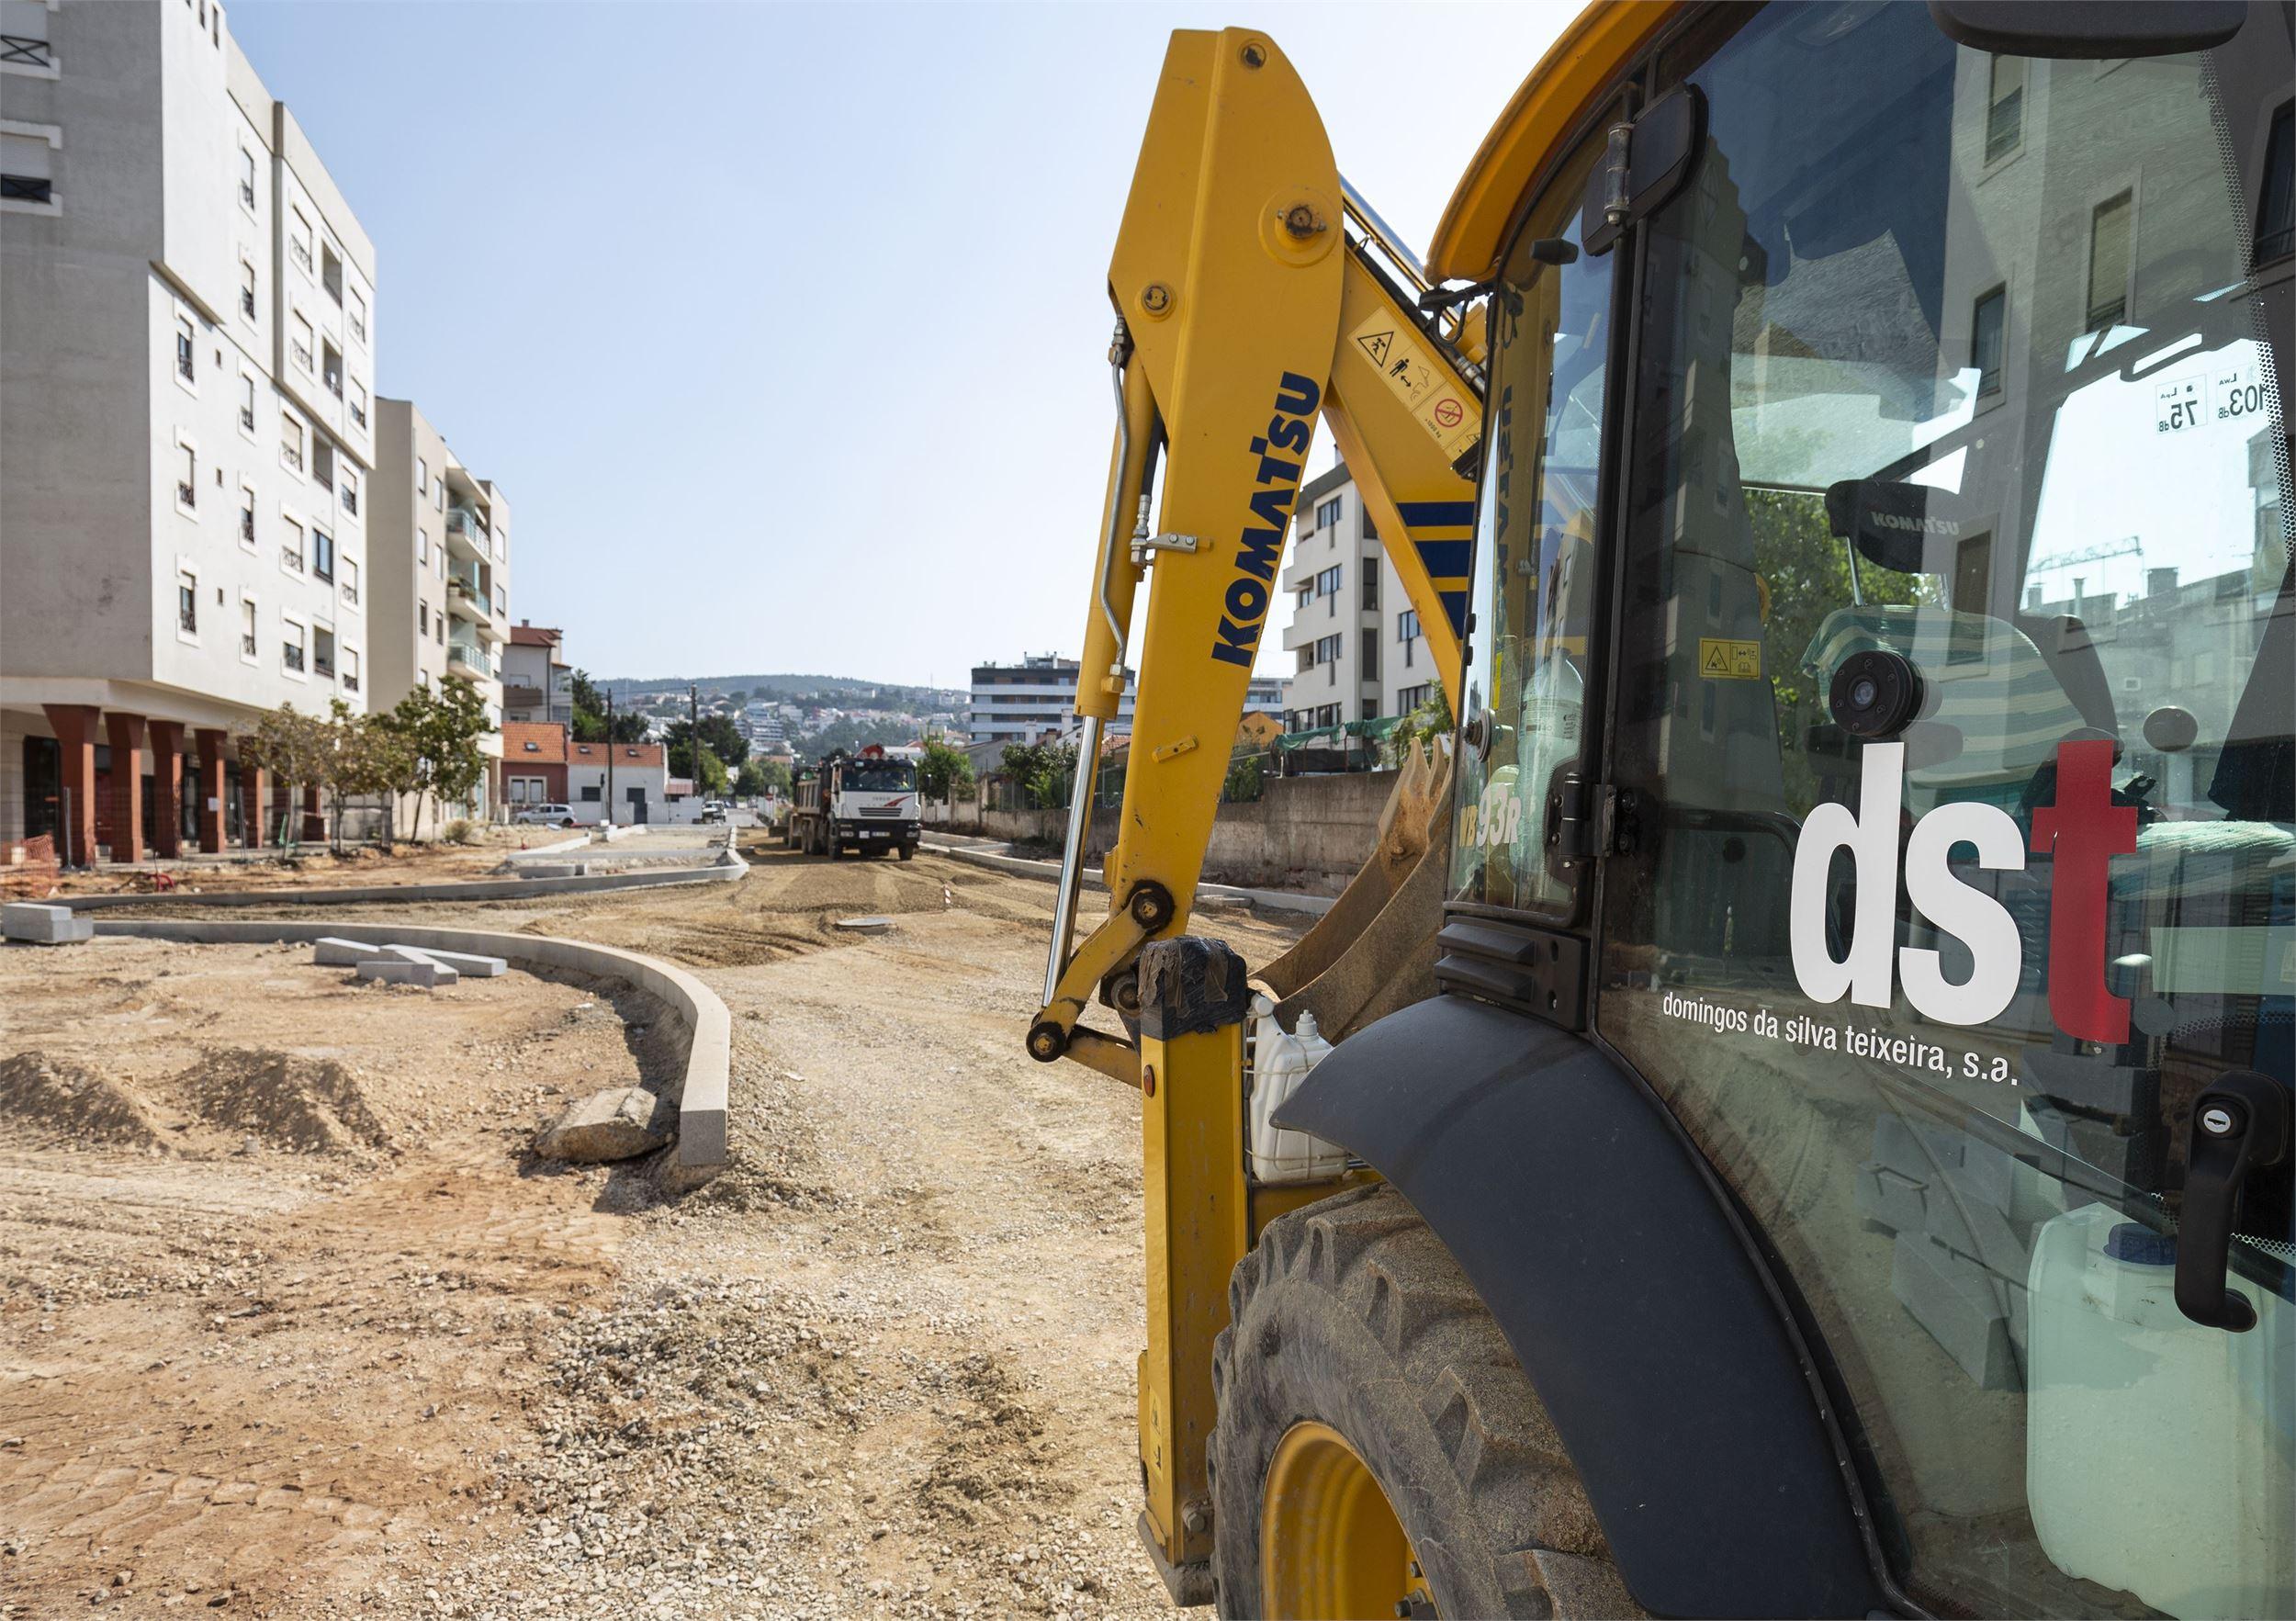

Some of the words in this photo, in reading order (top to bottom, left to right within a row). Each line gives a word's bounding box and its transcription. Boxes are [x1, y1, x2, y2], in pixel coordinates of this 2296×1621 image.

[1210, 371, 1320, 669] KOMATSU
[1871, 512, 1959, 535] KOMATSU
[1790, 739, 2138, 1044] dst
[1662, 992, 1748, 1032] domingos
[1753, 1009, 1778, 1039] da
[1785, 1016, 1837, 1050] silva
[1845, 1025, 1953, 1079] teixeira,
[1963, 1052, 2019, 1086] s.a.
